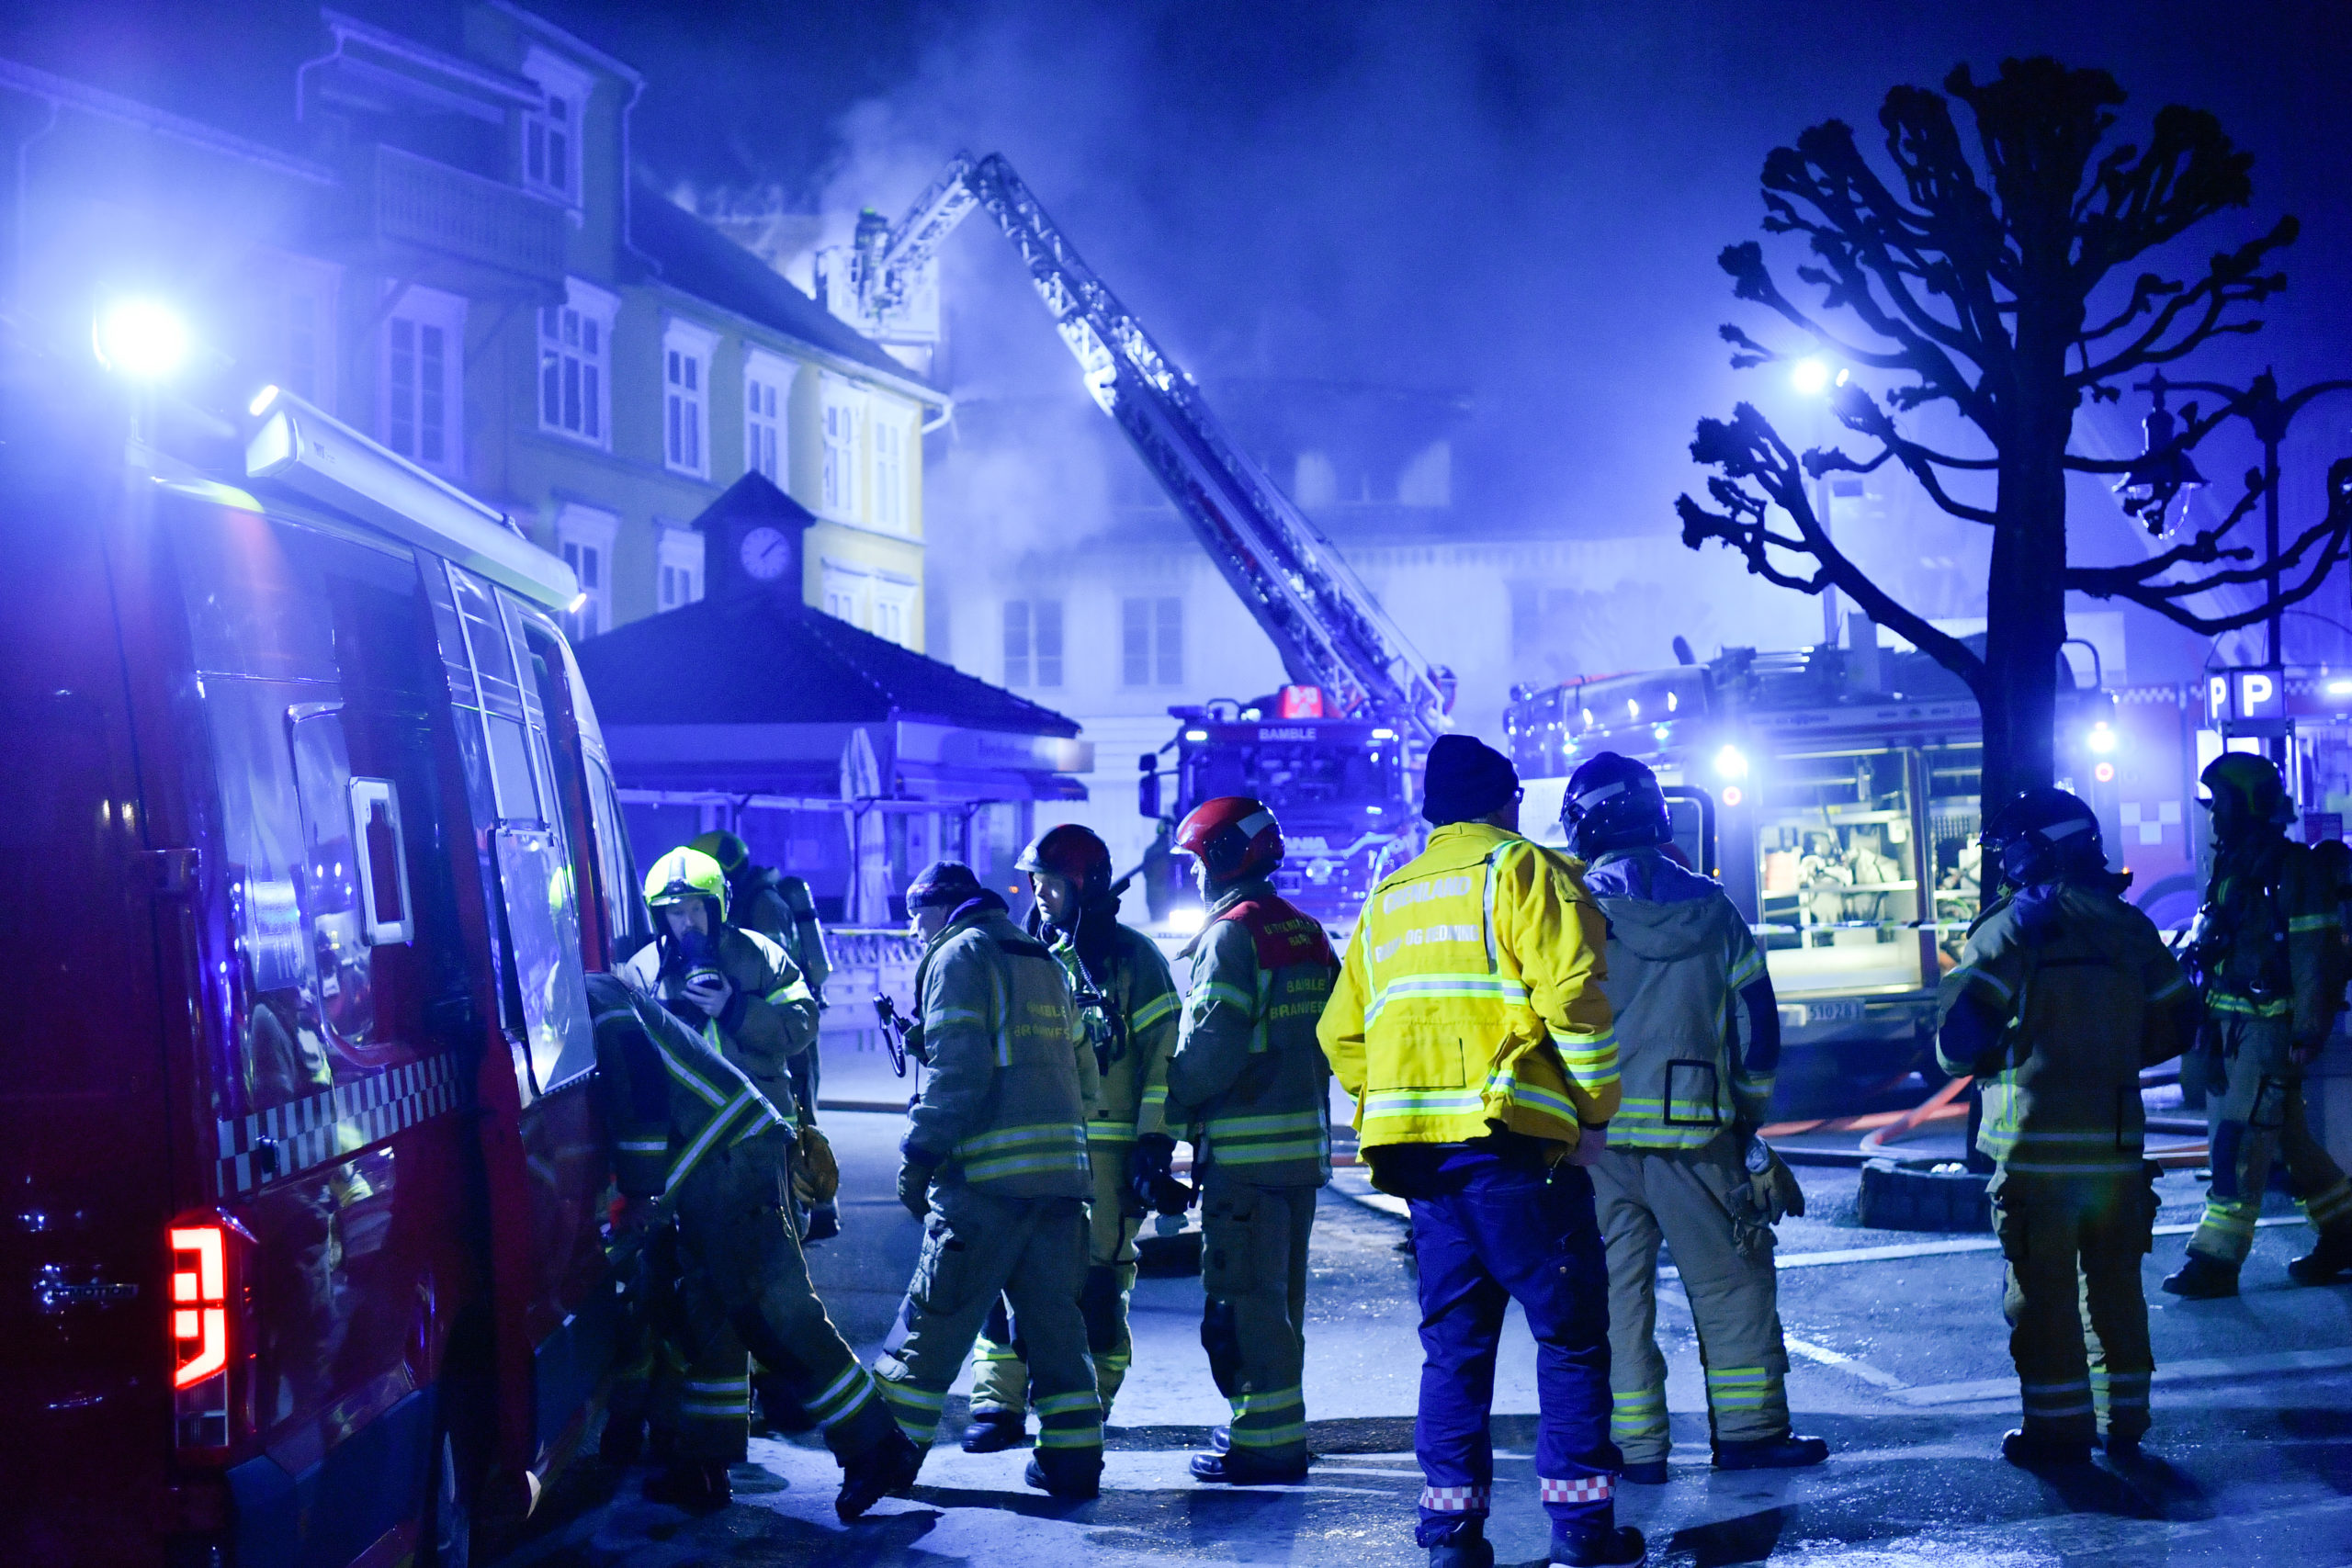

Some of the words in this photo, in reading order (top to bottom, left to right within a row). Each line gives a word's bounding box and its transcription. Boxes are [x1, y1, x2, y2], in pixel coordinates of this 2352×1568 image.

[2210, 677, 2227, 719] P
[2242, 674, 2273, 716] P
[1259, 728, 1317, 741] BAMBLE
[1283, 837, 1329, 852] ANIA
[1384, 876, 1472, 915] GRENLAND
[1406, 929, 1423, 946] OG
